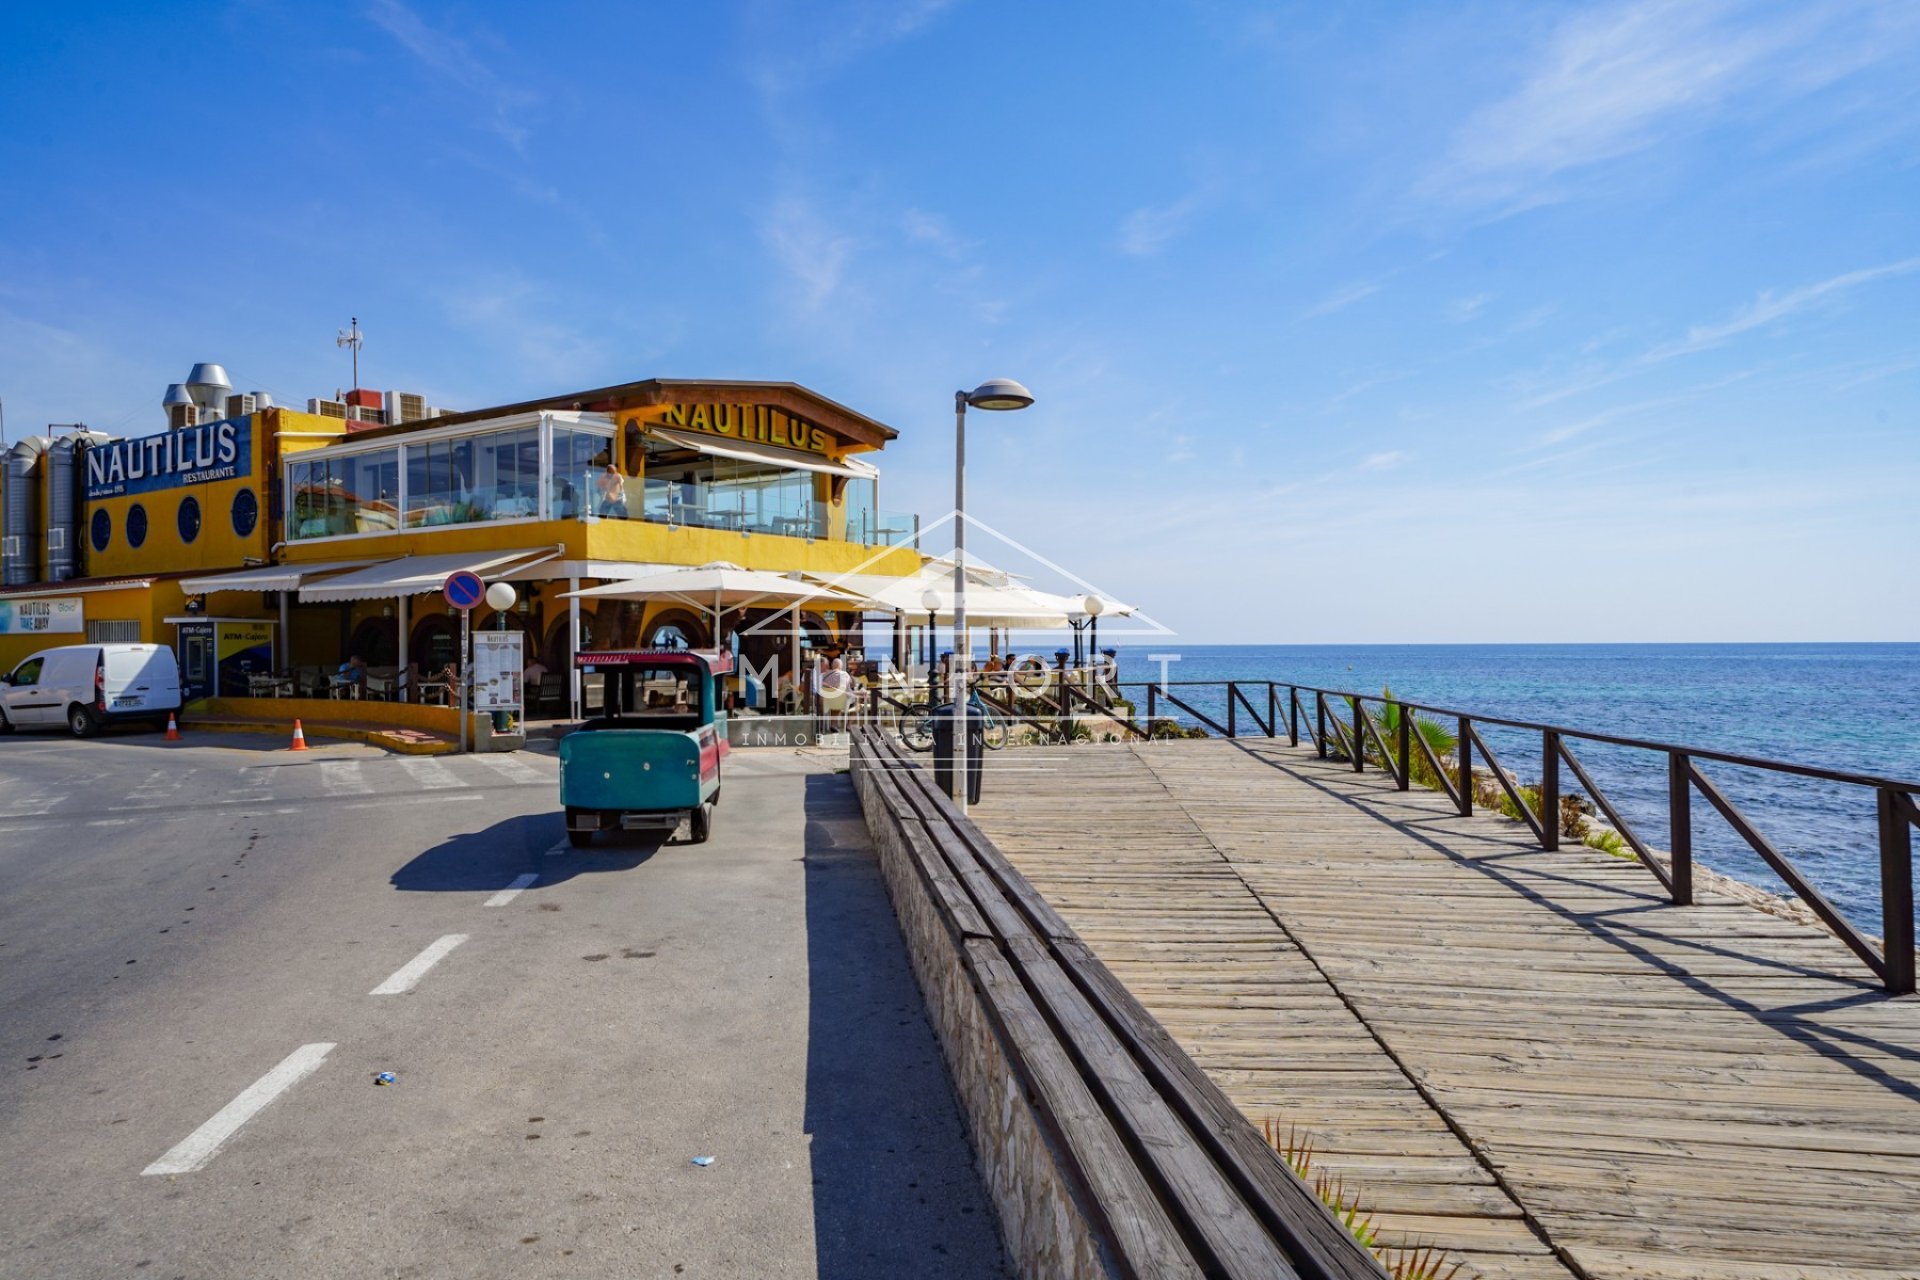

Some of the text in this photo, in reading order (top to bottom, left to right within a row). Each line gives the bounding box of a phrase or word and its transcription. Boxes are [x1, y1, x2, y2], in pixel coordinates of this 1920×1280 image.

[665, 403, 826, 450] NAUTILUS
[88, 423, 236, 487] NAUTILUS
[182, 466, 235, 483] RESTAURANTE
